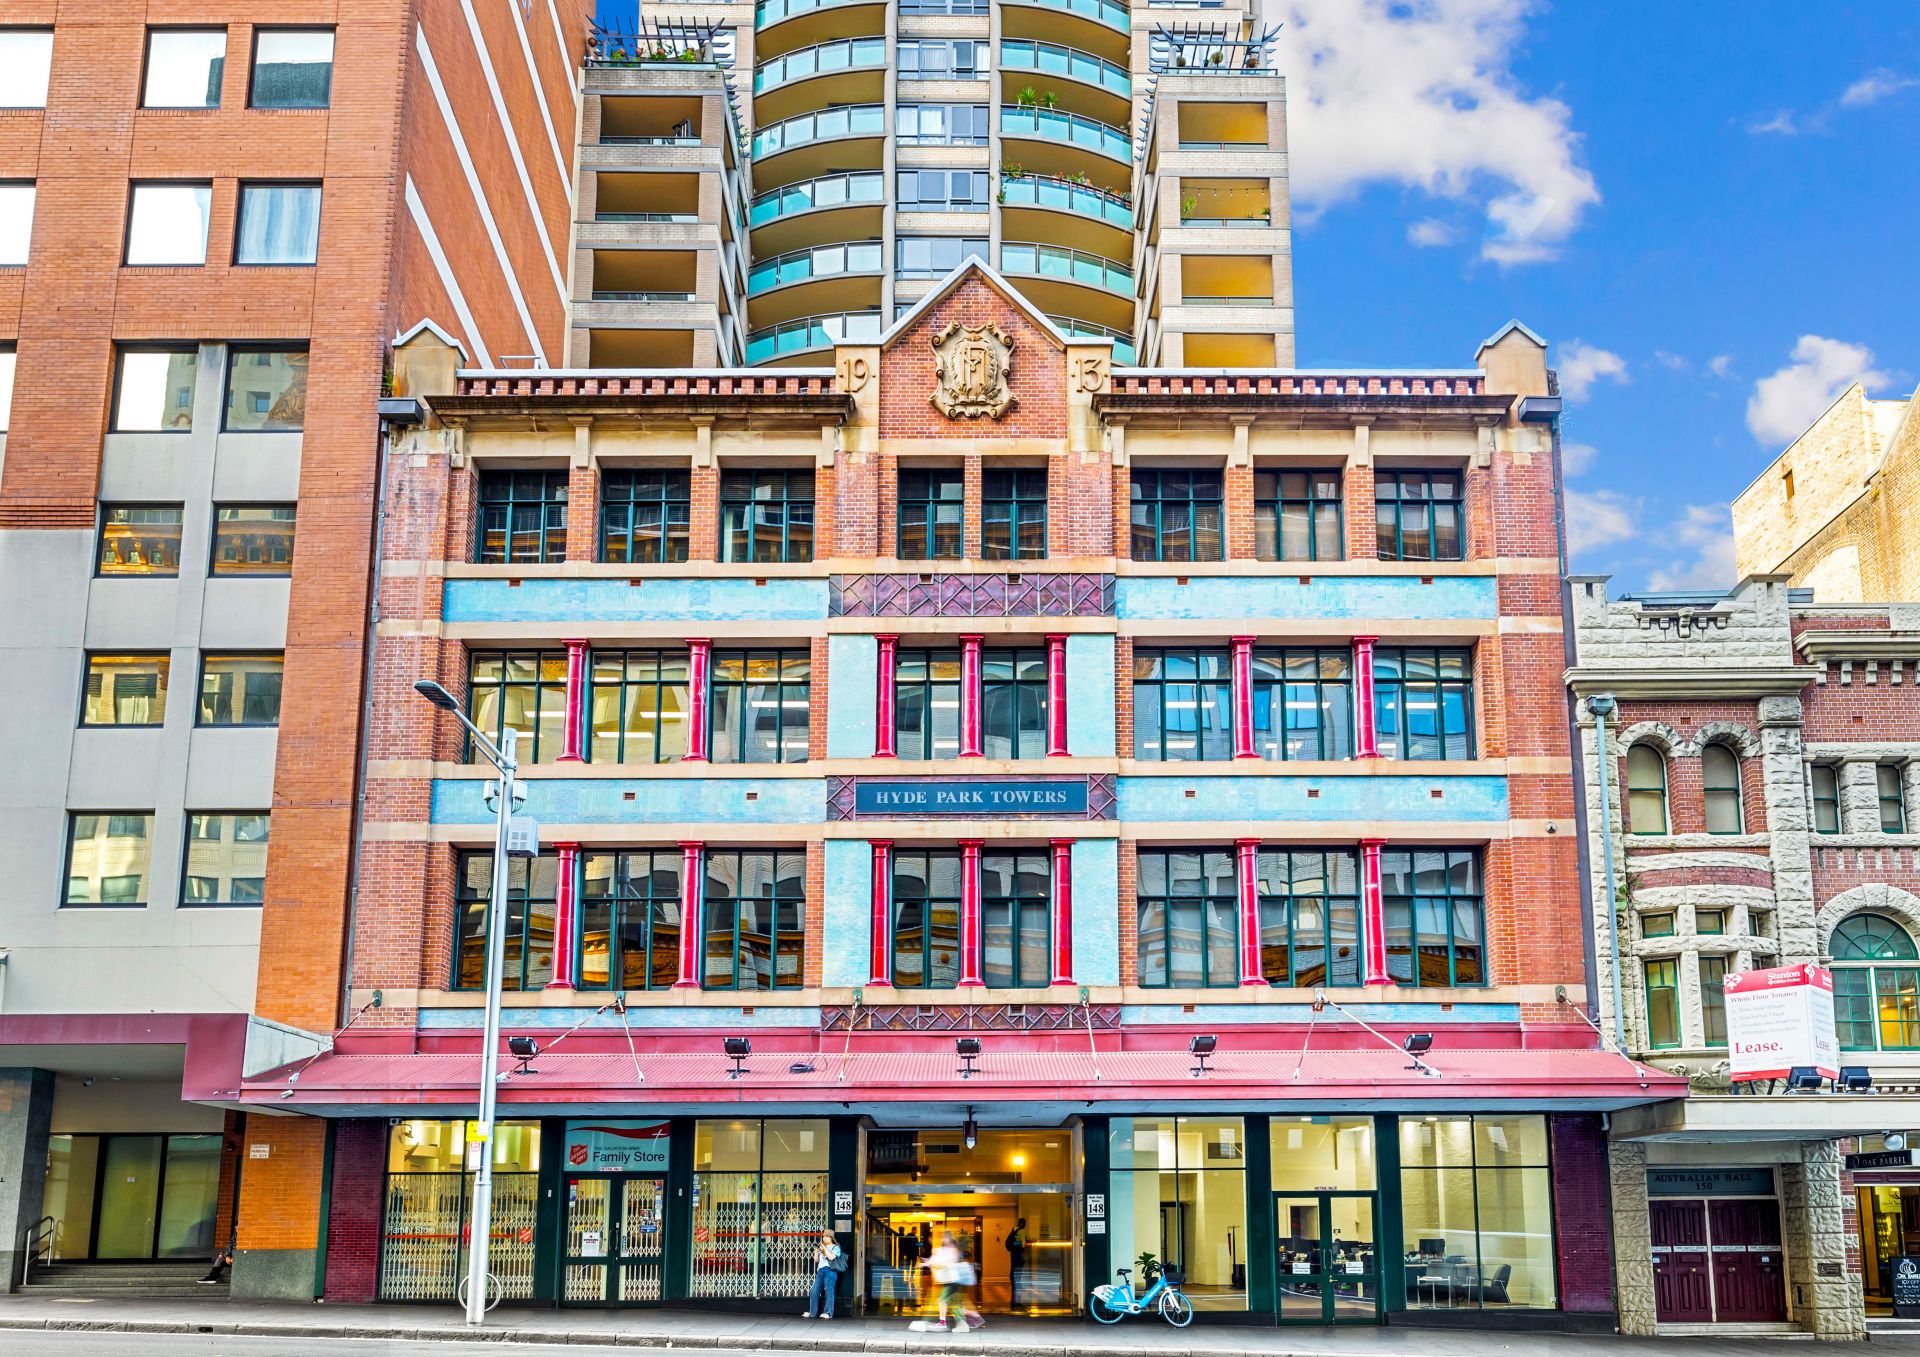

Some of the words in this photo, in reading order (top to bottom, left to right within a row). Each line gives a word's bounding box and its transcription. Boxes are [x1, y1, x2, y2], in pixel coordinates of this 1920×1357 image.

[842, 358, 870, 393] 19
[1075, 358, 1104, 393] 13
[876, 791, 927, 804] HYDE
[936, 791, 984, 803] PARK
[991, 790, 1067, 803] TOWERS
[1767, 971, 1801, 980] Stanton
[1771, 991, 1797, 999] Tenancy
[1735, 1042, 1783, 1054] Lease.
[593, 1151, 631, 1165] Family
[633, 1151, 665, 1162] Store
[1862, 1158, 1877, 1167] OAK
[1879, 1156, 1907, 1166] BARREL
[1655, 1174, 1720, 1183] AUSTRALIAN
[1725, 1173, 1753, 1181] HALL
[1696, 1182, 1713, 1191] 150
[836, 1200, 852, 1211] 148
[1088, 1203, 1104, 1214] 148
